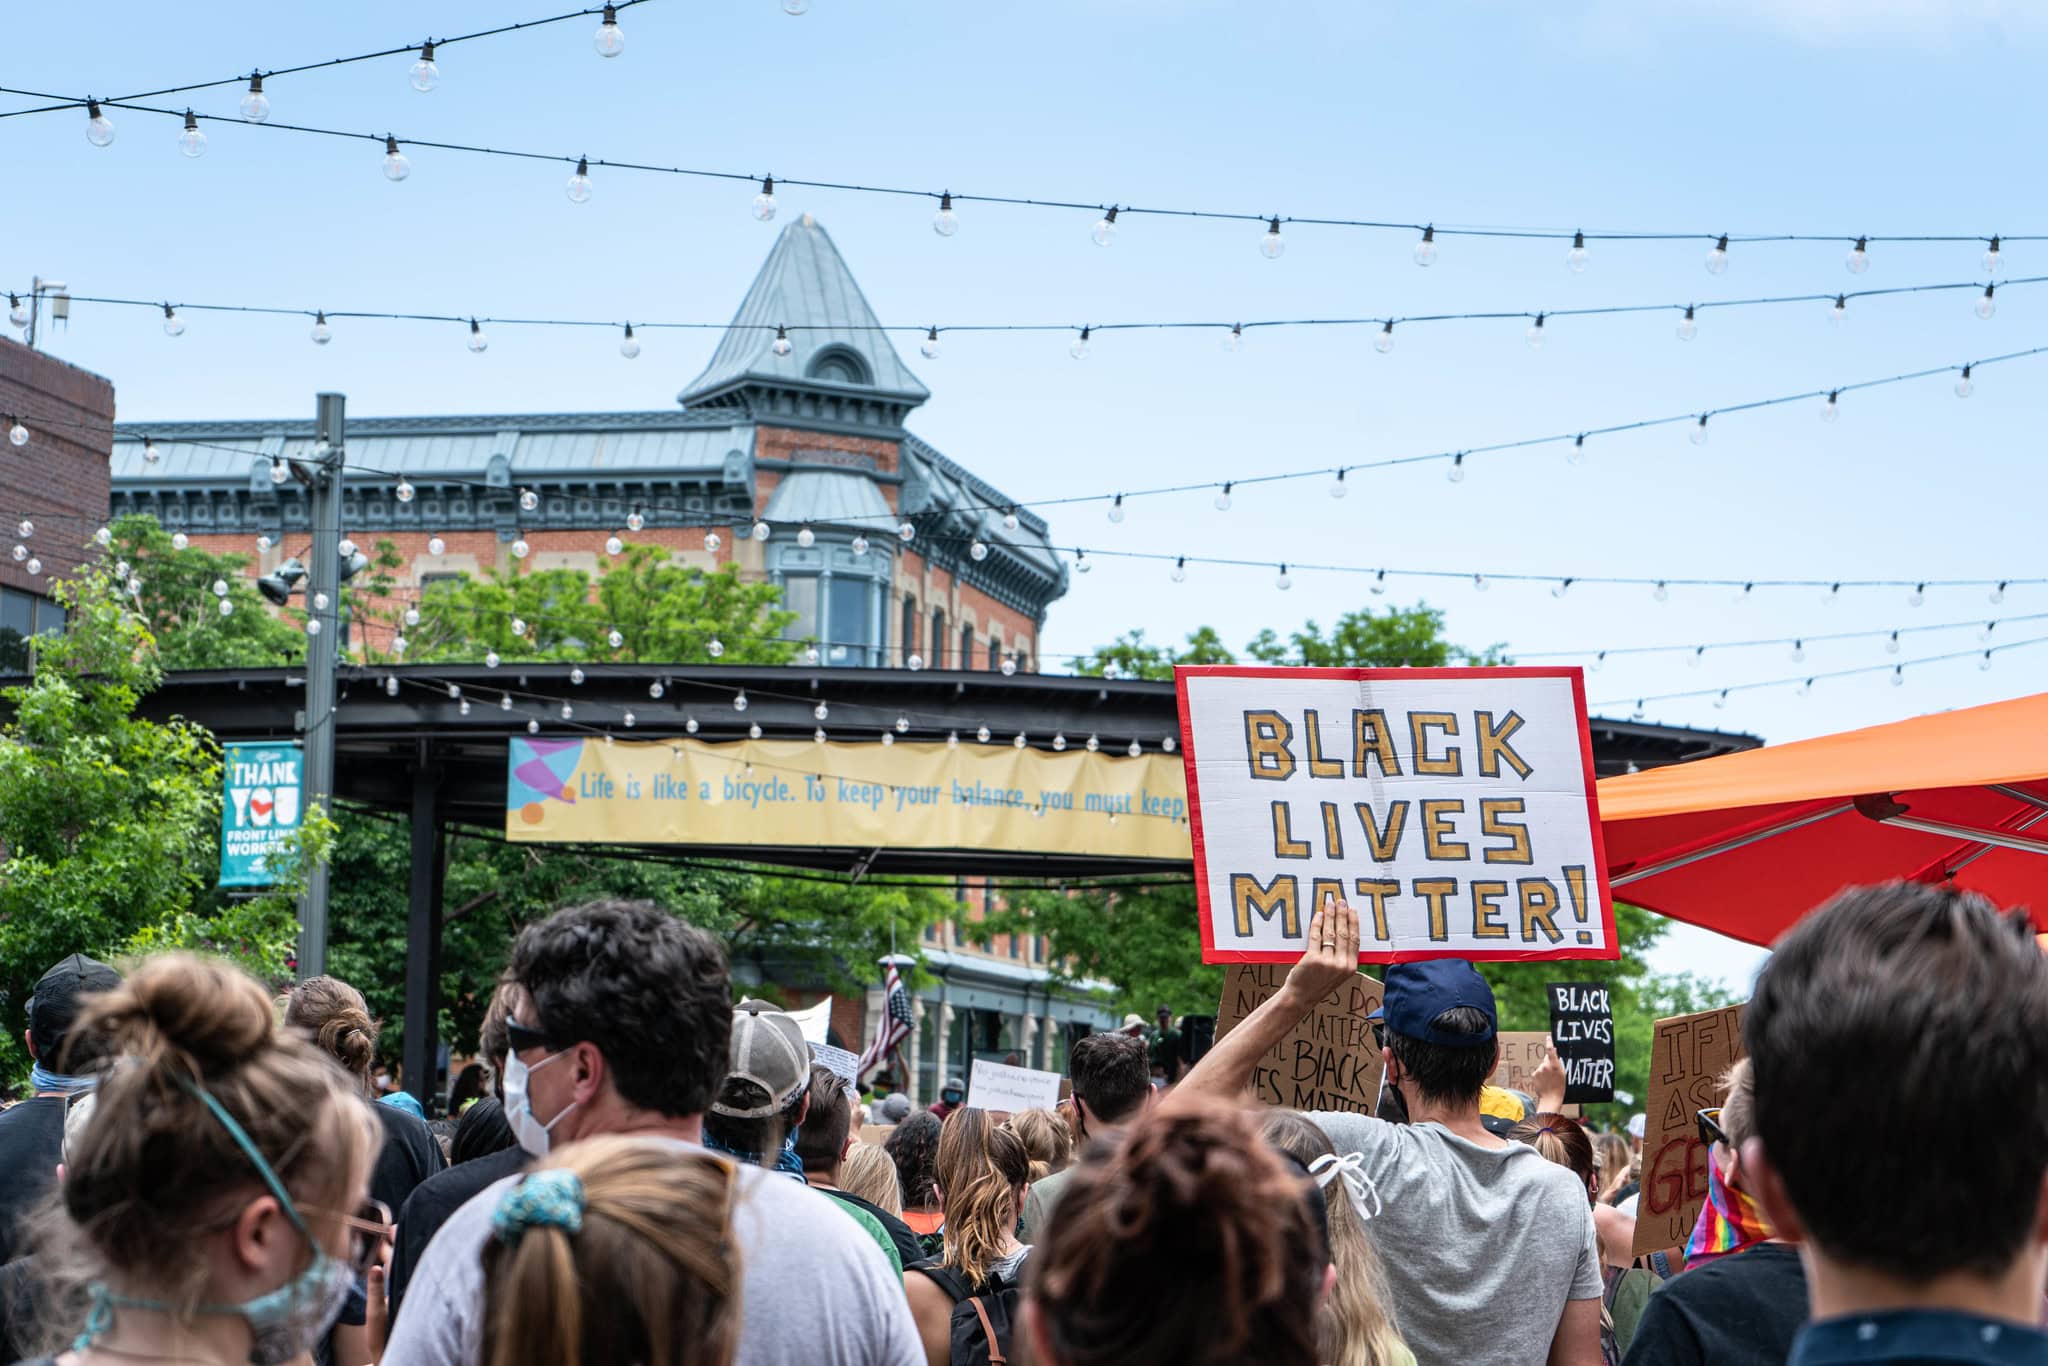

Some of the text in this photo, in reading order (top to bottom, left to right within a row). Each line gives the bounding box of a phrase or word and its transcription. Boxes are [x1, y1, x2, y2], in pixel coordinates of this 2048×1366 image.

[1243, 708, 1534, 781] BLACK
[234, 761, 298, 785] THANK
[229, 787, 299, 827] YOU
[580, 773, 1185, 823] Life is like a bicycle. To keep your balance, you must keep
[227, 841, 297, 856] WORKR
[1271, 798, 1534, 865] LIVES
[1230, 865, 1593, 945] MATTER!
[1556, 987, 1610, 1013] BLACK
[1302, 1008, 1374, 1057] MATTER
[1557, 1018, 1613, 1044] LIVES
[1661, 1014, 1719, 1085] IF
[1560, 1057, 1614, 1089] MATTER
